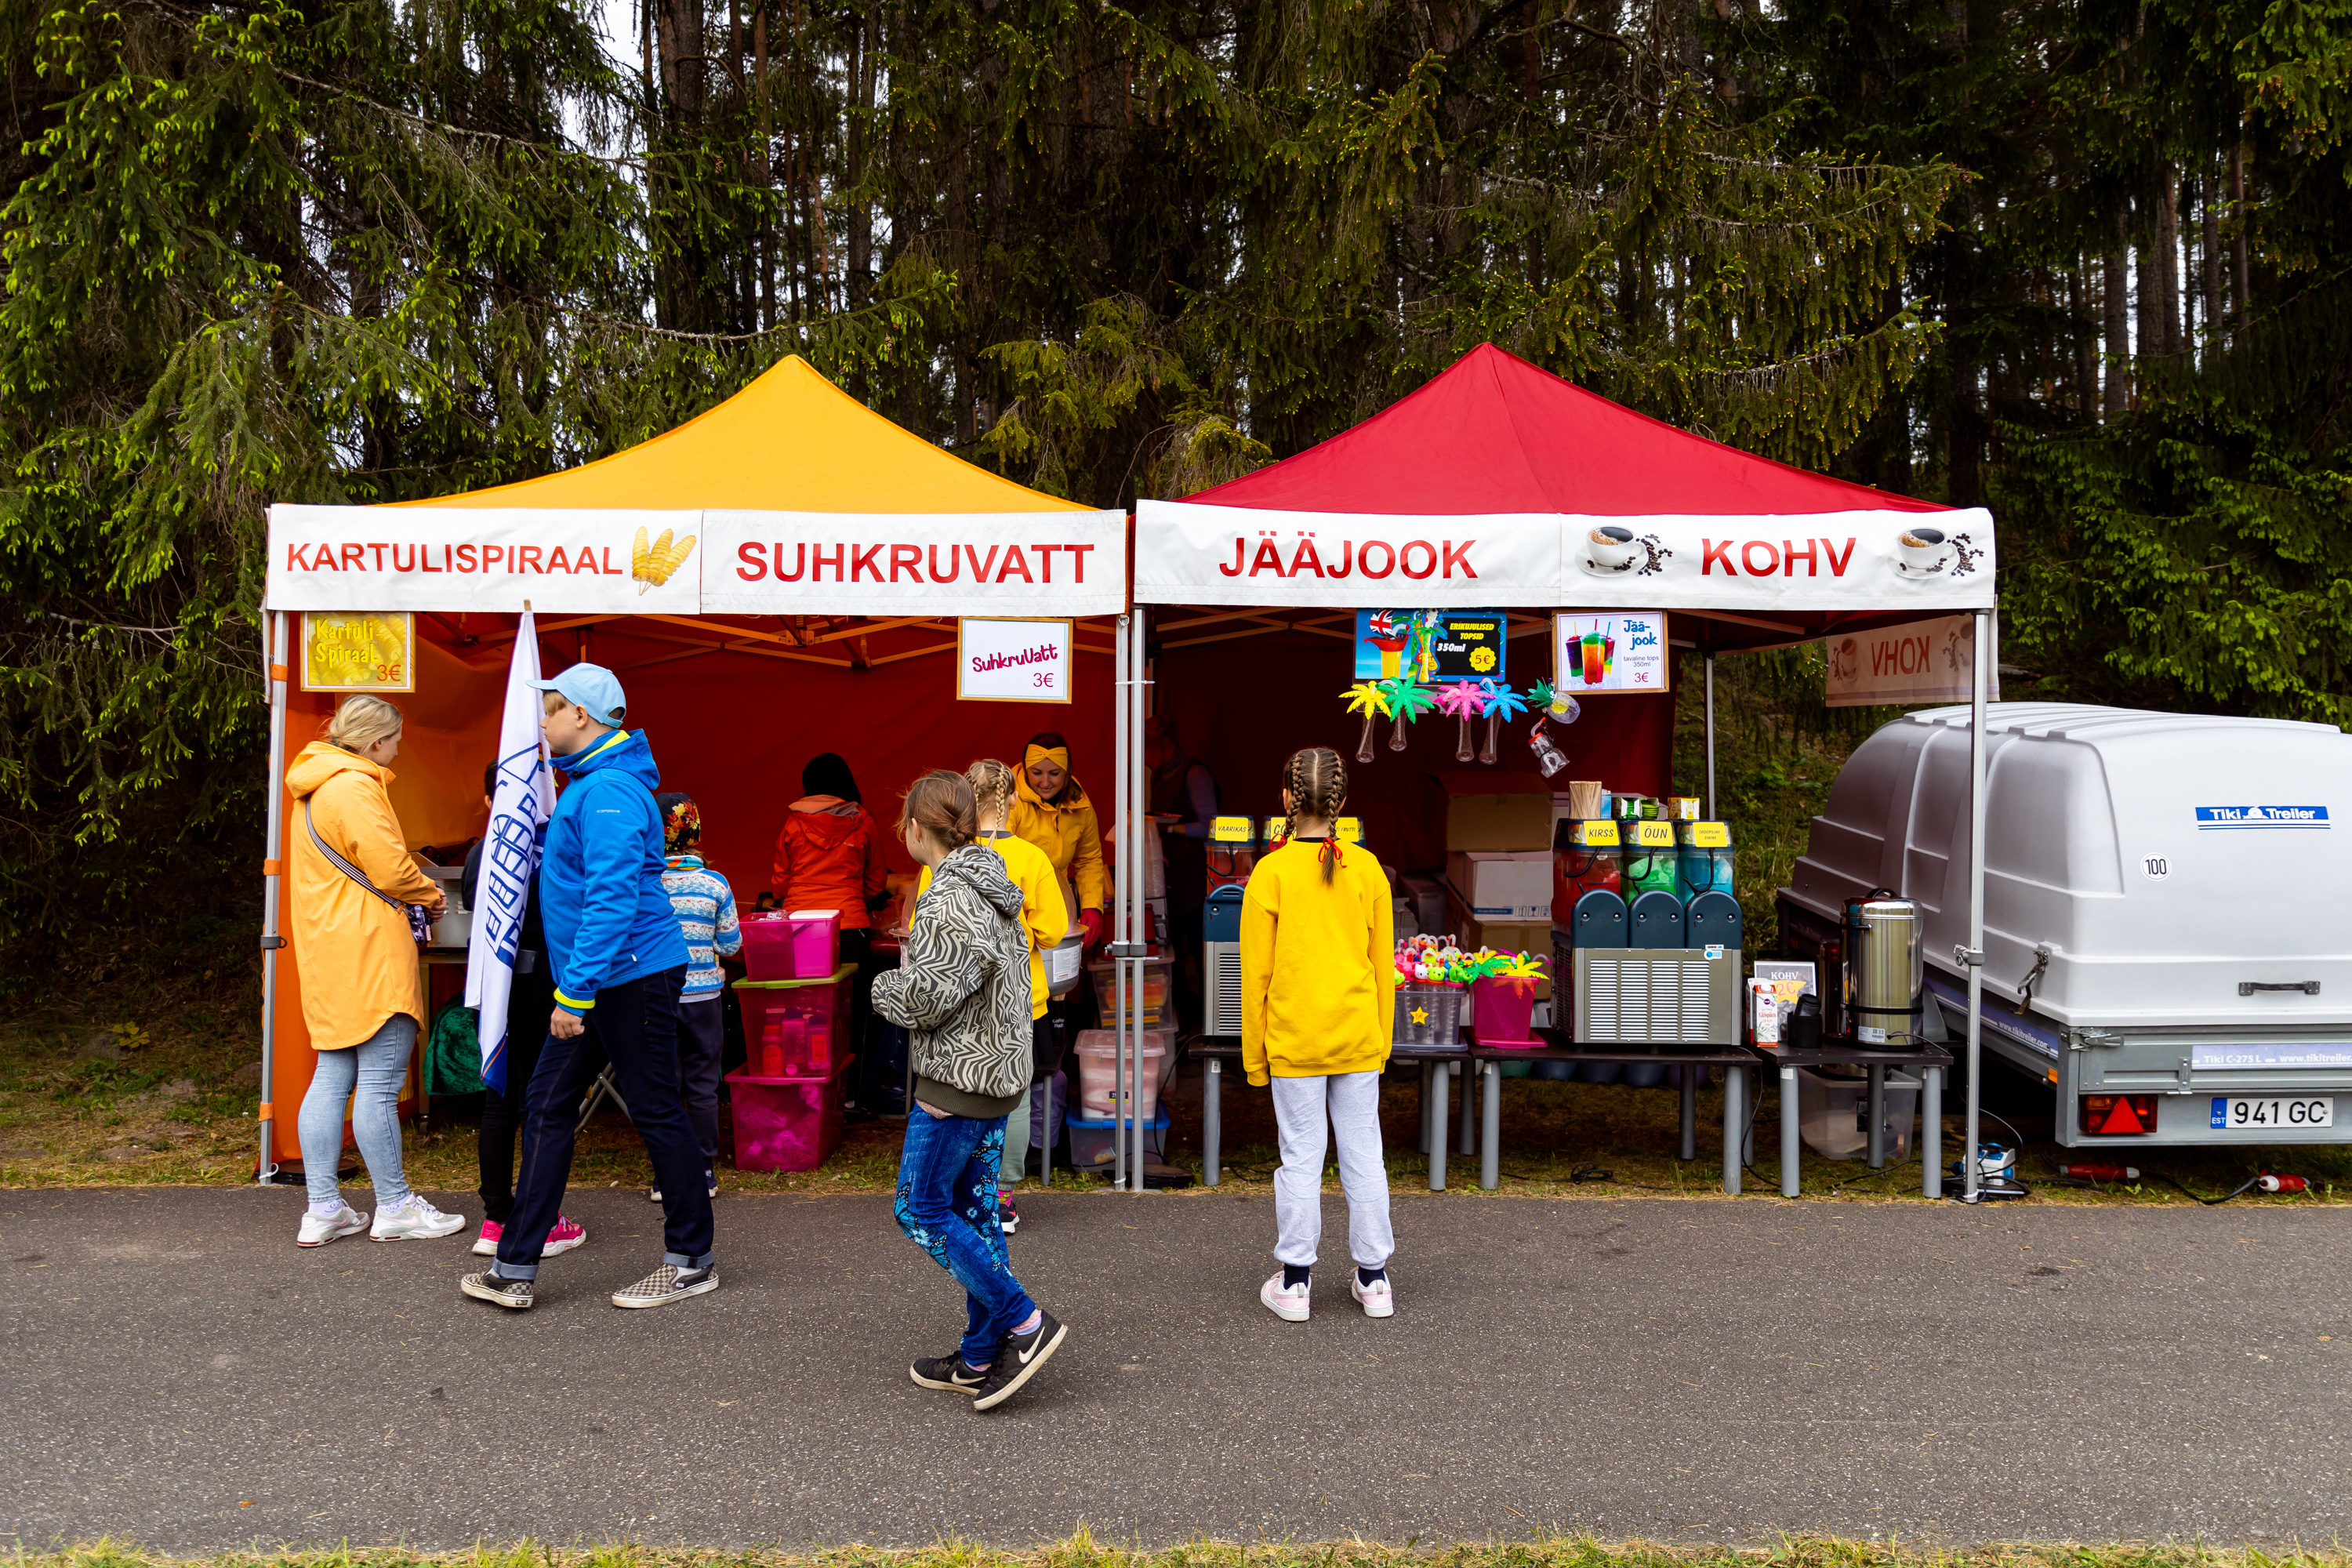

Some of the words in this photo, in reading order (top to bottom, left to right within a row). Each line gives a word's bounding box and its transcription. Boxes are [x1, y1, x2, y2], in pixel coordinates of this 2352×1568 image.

[286, 543, 623, 575] KARTULISPIRAAL
[1219, 530, 1479, 579] JÄÄJOOK
[1700, 537, 1857, 578] KOHV
[736, 541, 1094, 584] SUHKRUVATT
[1449, 622, 1495, 631] ERIKUJULISED
[1436, 642, 1466, 652] 350ml
[1629, 631, 1658, 651] jook
[376, 664, 401, 682] 3€
[1634, 672, 1649, 683] 3€
[1033, 673, 1054, 688] 3€
[2209, 808, 2241, 820] Tiki
[2265, 808, 2316, 820] Treiler
[1588, 829, 1614, 837] KIRSS
[1644, 825, 1668, 839] ÕUN
[2145, 858, 2167, 875] 100
[1770, 971, 1799, 980] KOHV
[1776, 982, 1796, 996] 2€
[2204, 1055, 2224, 1064] Tiki
[2225, 1054, 2254, 1064] C-275
[2256, 1054, 2262, 1063] L
[2234, 1102, 2280, 1124] 941
[2288, 1101, 2325, 1123] GC
